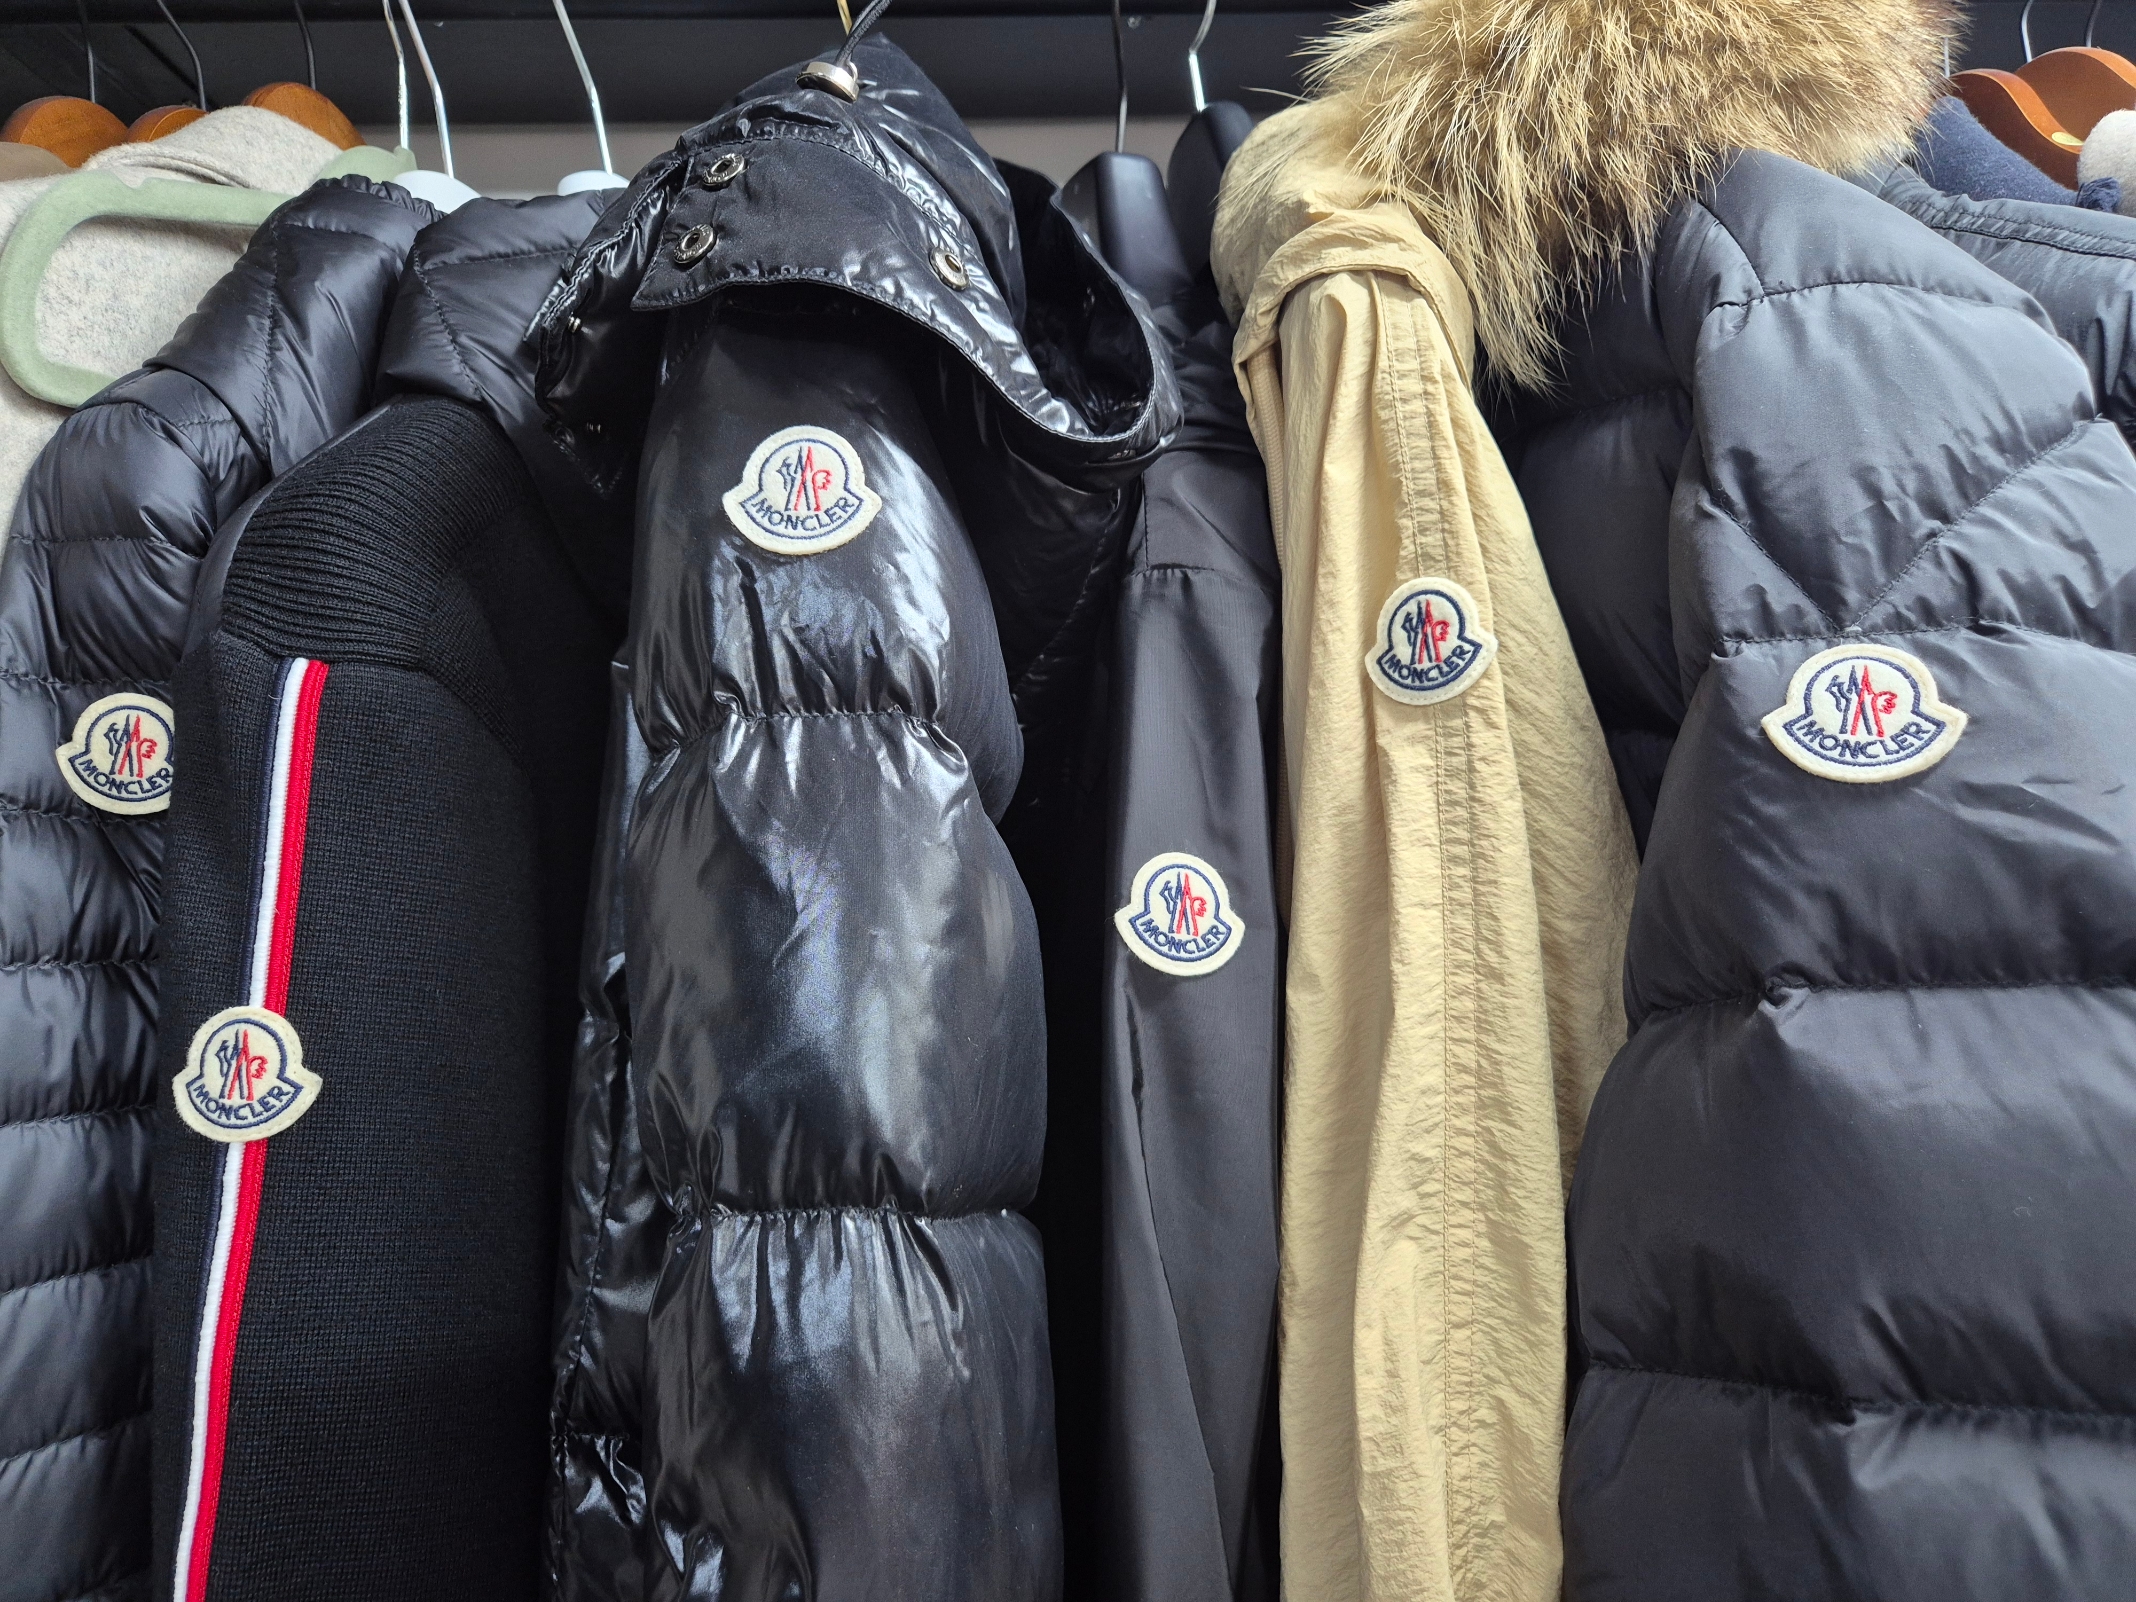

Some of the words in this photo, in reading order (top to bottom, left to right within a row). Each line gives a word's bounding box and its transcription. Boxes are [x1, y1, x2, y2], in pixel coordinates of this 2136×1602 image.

[751, 497, 855, 531] MONCLER
[1384, 645, 1471, 684] MONCLER
[1796, 719, 1931, 759] MONCLER
[78, 758, 173, 795] MONCLER
[1139, 918, 1225, 955] MONCLER
[193, 1083, 291, 1121] MONCLER
